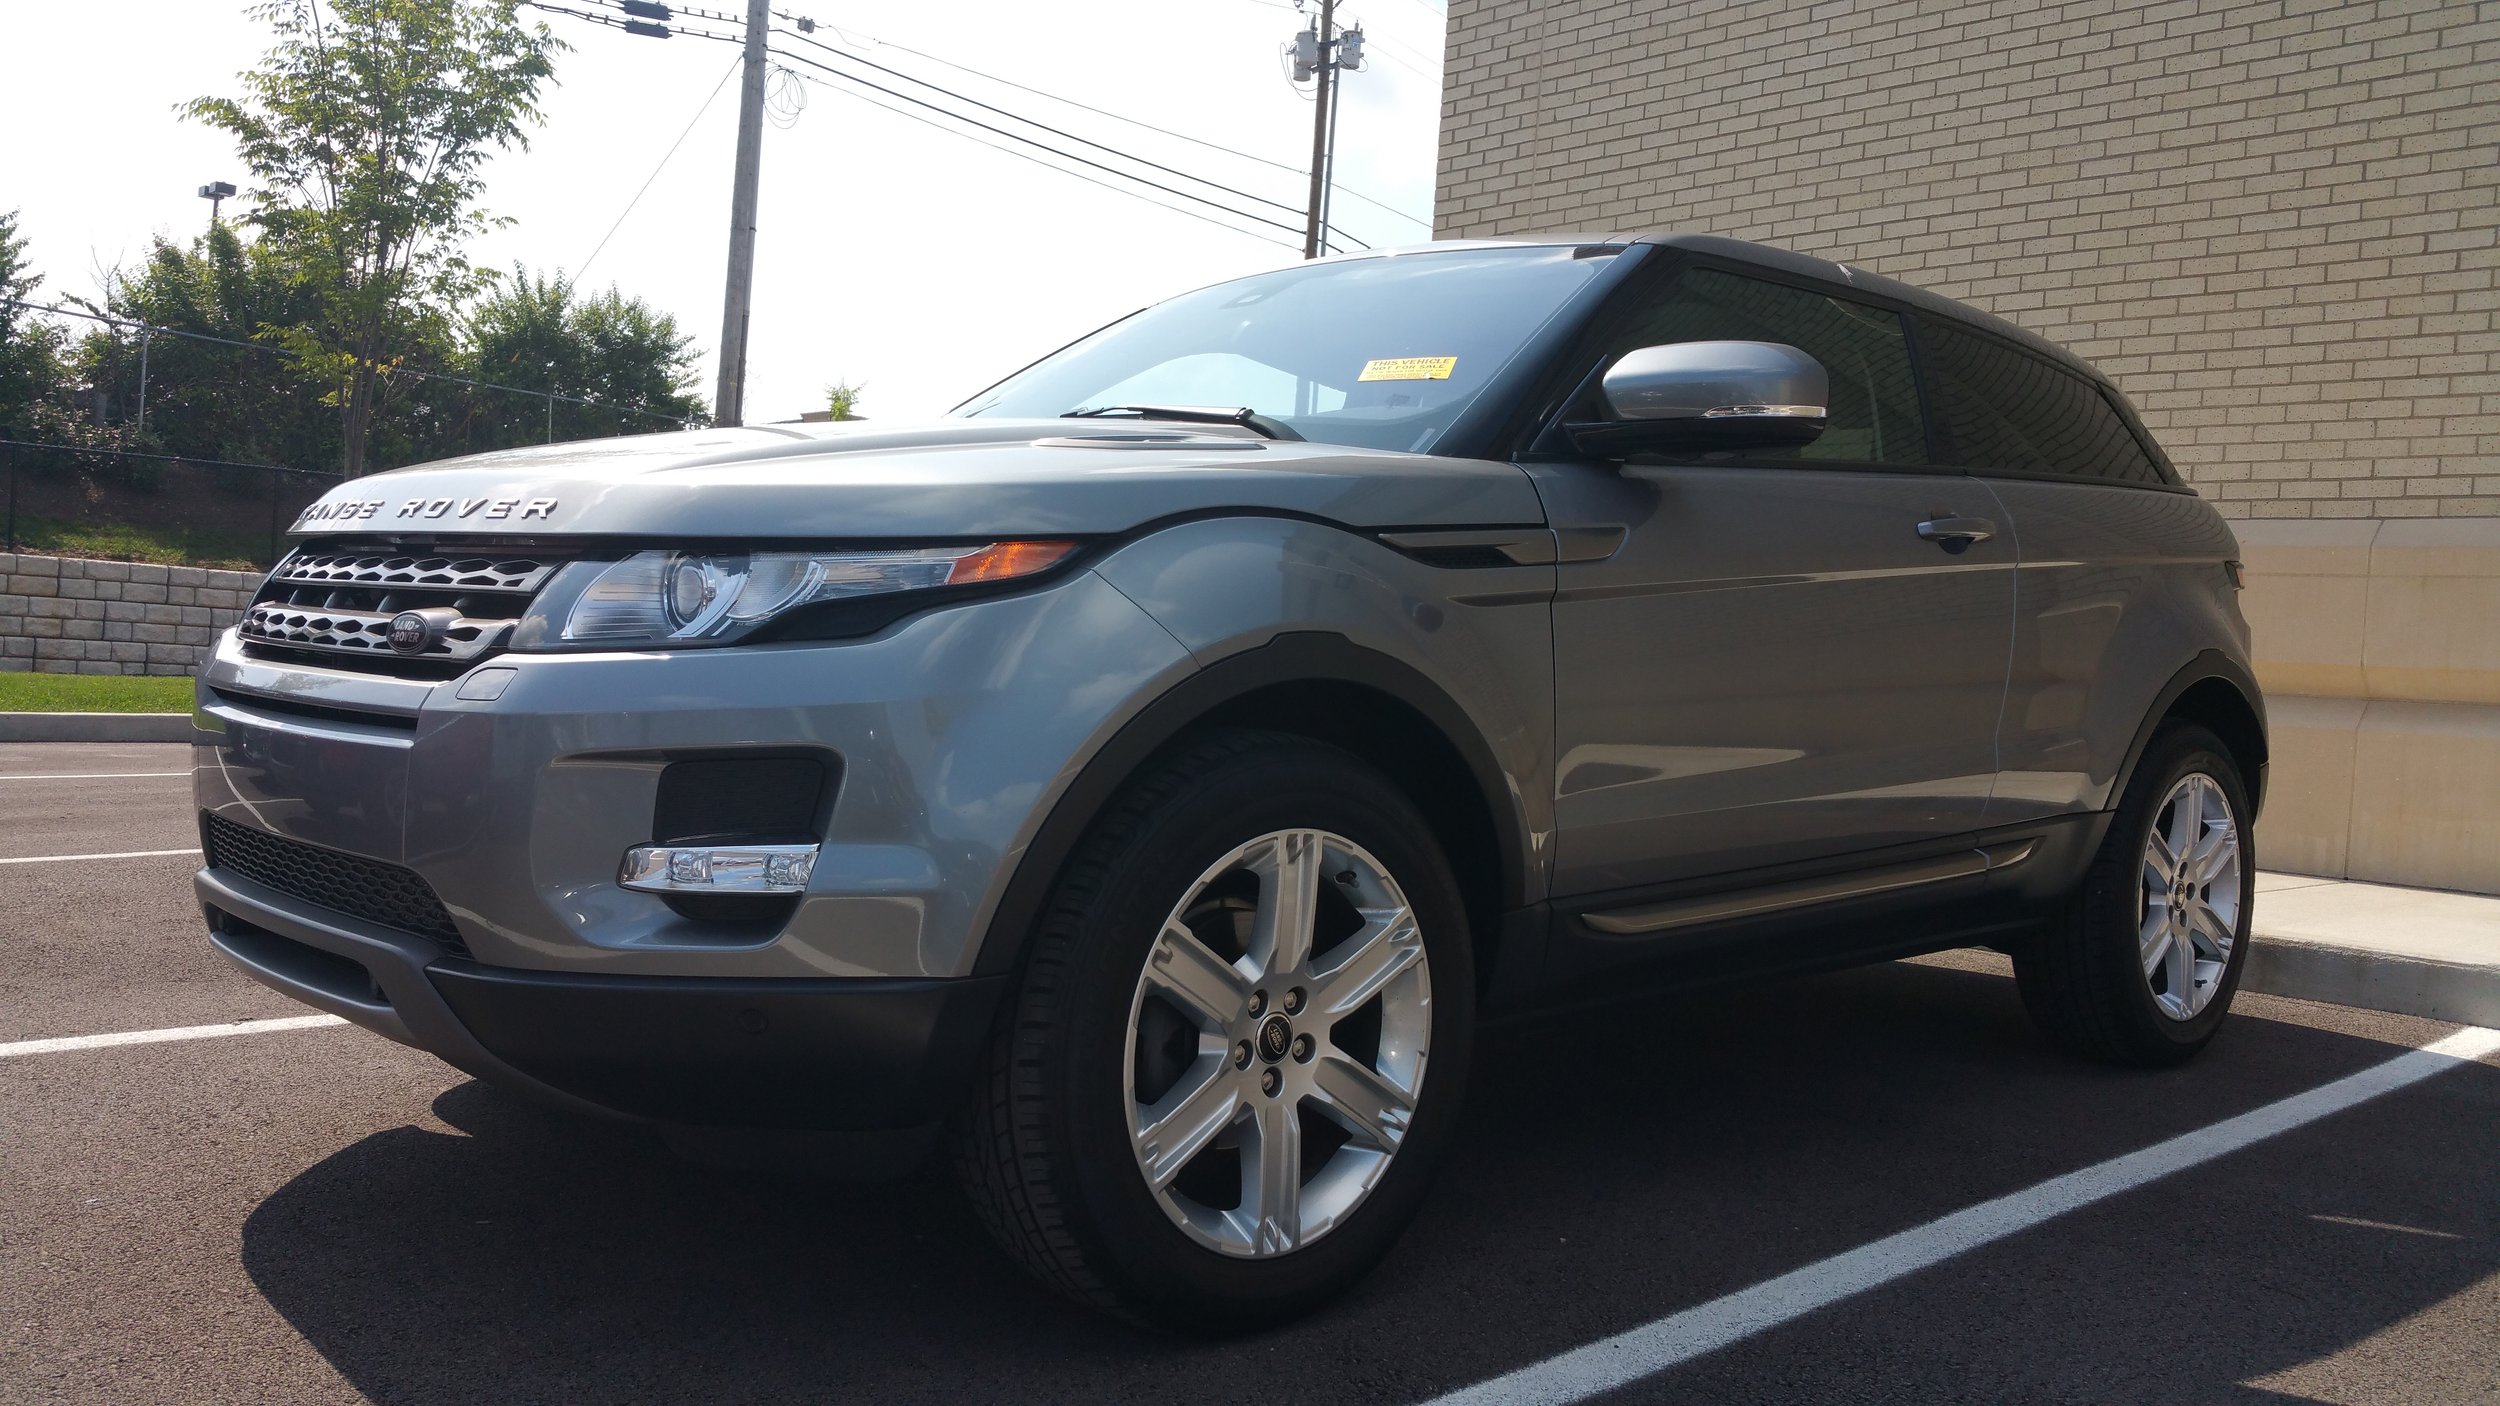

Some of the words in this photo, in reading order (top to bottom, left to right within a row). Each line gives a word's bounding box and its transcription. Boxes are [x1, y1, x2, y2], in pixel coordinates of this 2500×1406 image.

[300, 500, 385, 520] RANGE
[396, 497, 560, 519] ROVER
[394, 620, 416, 631] LAND
[394, 631, 420, 643] ROVER
